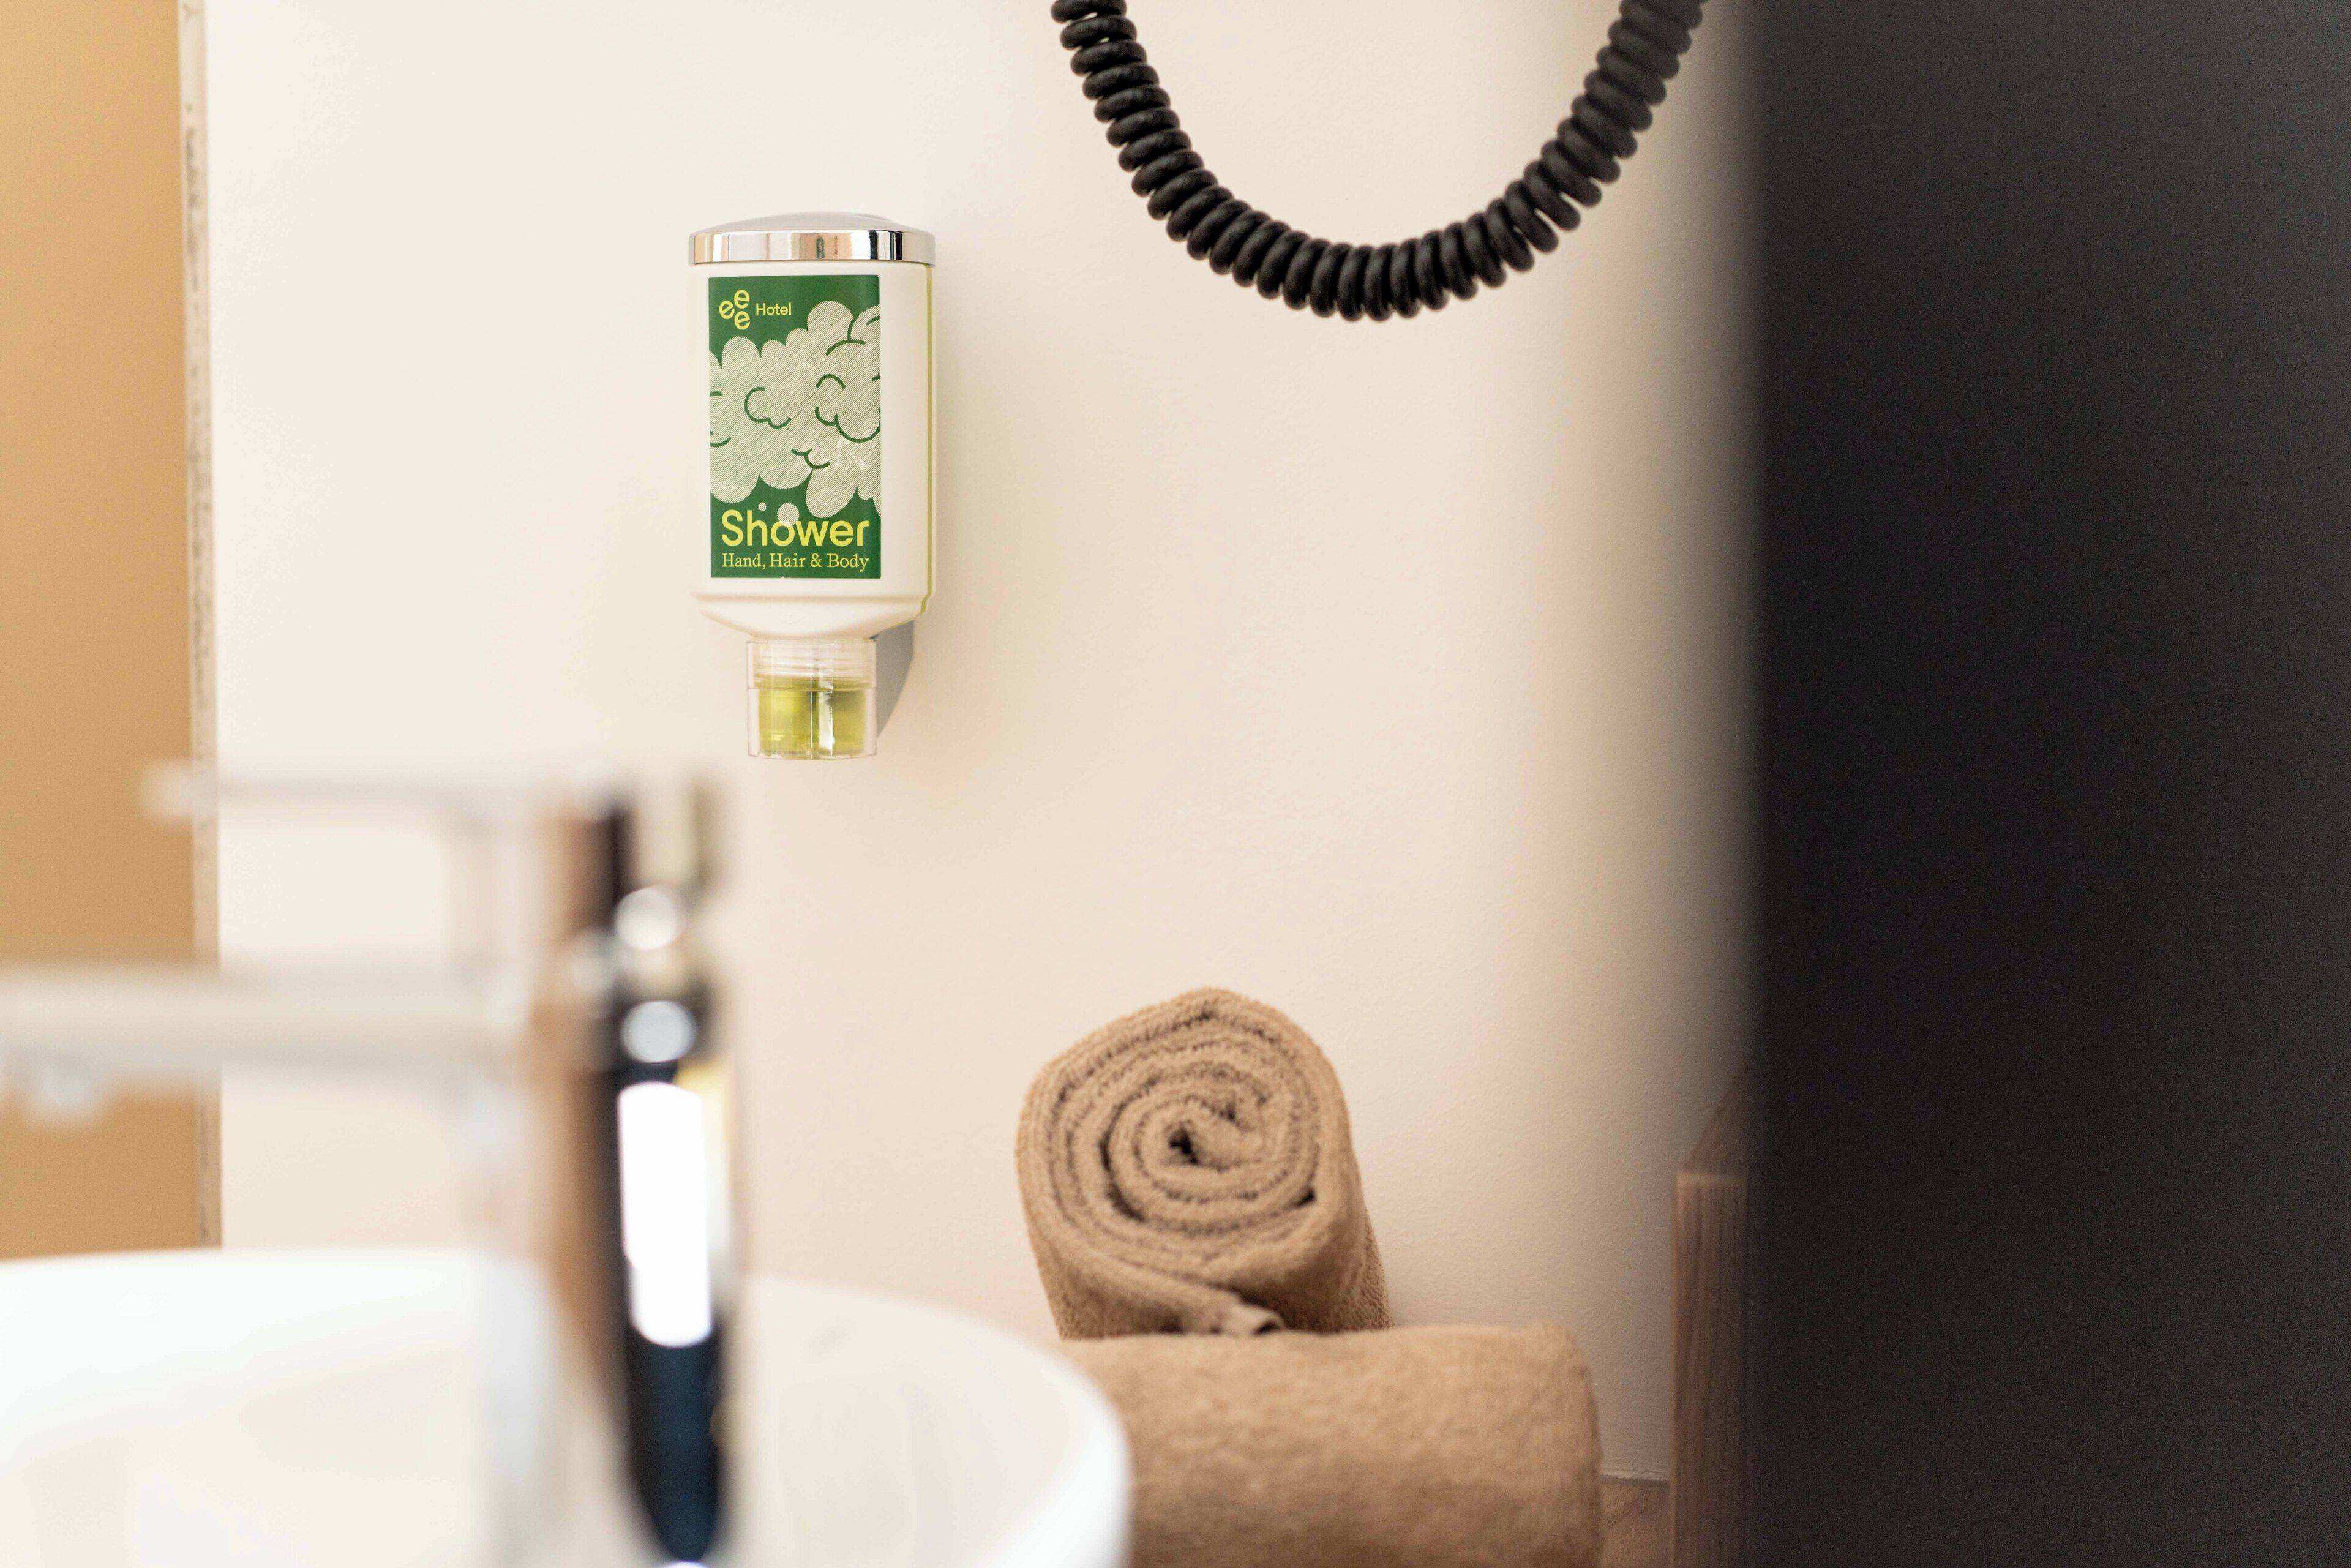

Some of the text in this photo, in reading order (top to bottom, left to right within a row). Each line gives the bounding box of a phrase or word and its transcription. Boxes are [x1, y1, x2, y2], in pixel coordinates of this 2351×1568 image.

[756, 302, 792, 317] Hotel
[721, 509, 871, 547] Shower
[722, 553, 869, 572] Hand, Hair & Body
